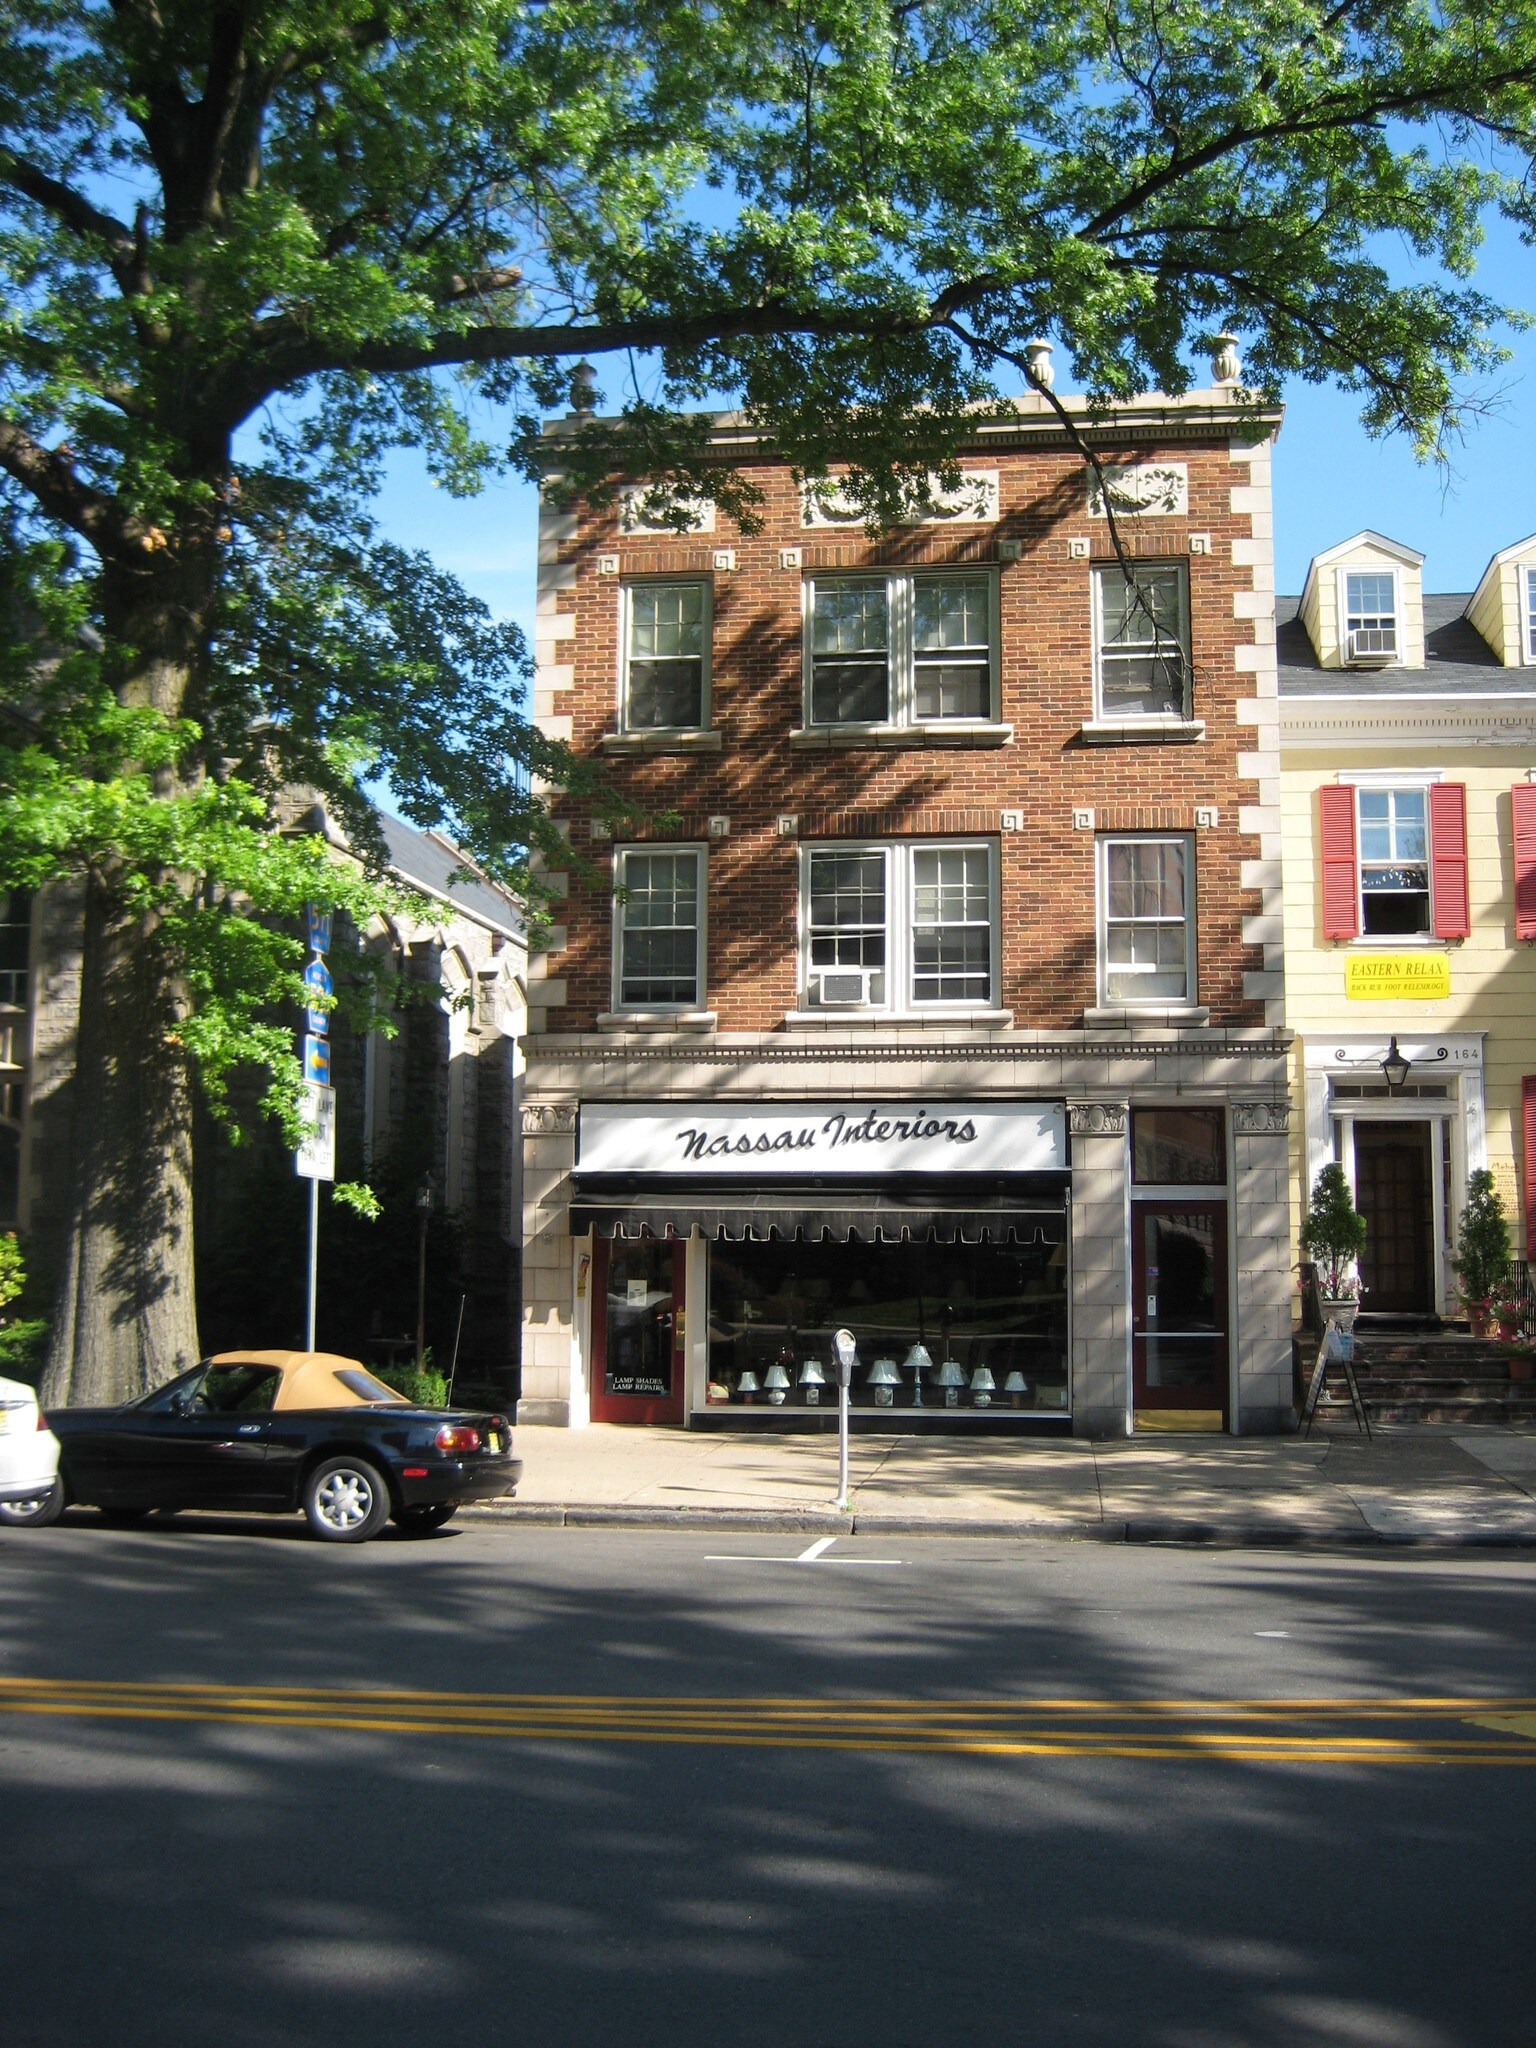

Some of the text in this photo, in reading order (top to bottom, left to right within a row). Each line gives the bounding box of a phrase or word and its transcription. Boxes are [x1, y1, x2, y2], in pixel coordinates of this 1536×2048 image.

[1351, 962, 1443, 976] EASTERN RELAX
[1454, 1049, 1478, 1060] 164
[677, 1110, 978, 1160] Nassau Interiors
[614, 1376, 663, 1385] LAMP SHADES
